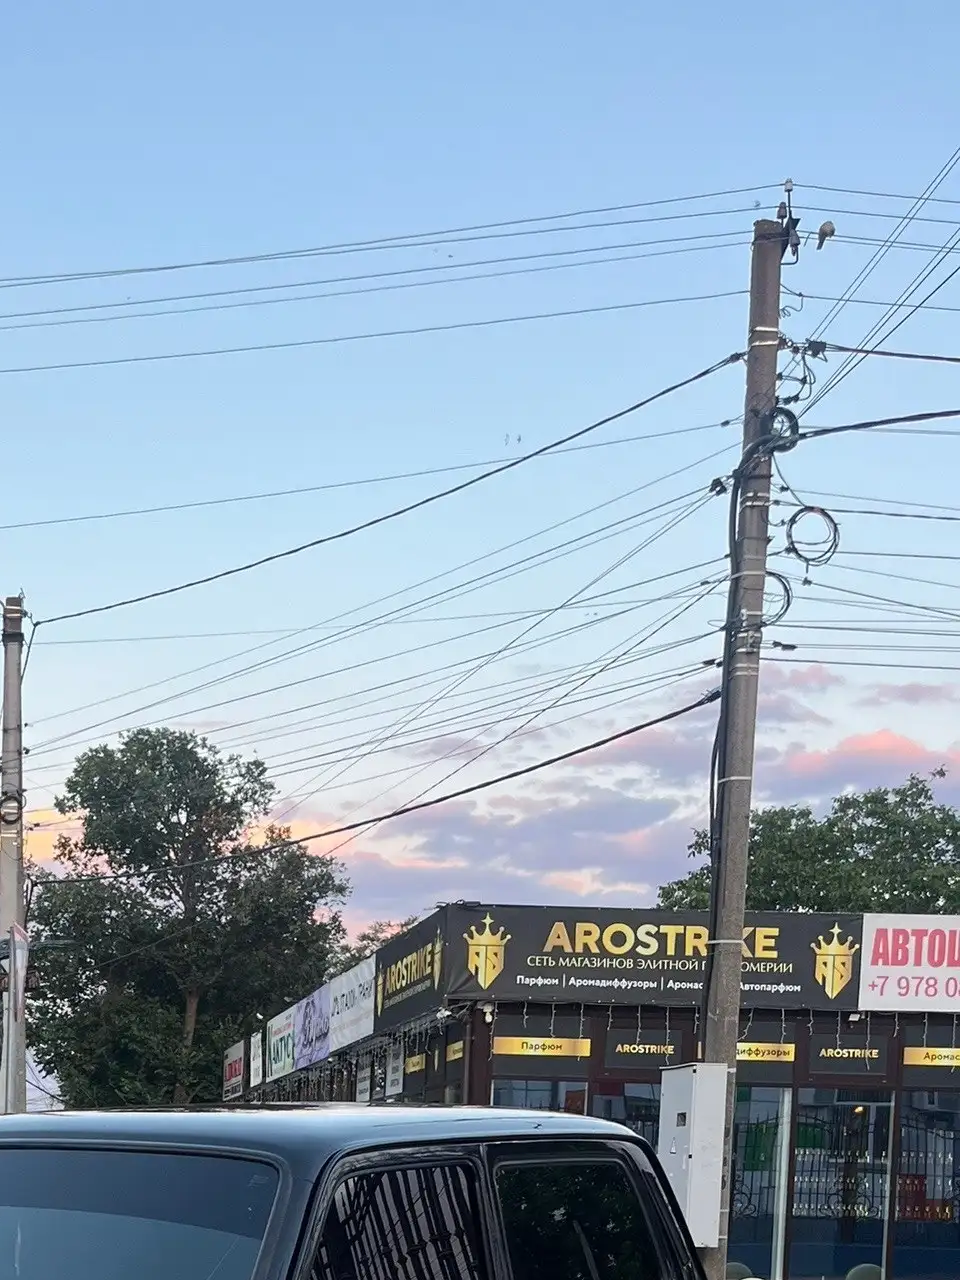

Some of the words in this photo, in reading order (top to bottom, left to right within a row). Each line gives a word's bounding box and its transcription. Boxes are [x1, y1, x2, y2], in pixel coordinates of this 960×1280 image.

[543, 921, 780, 959] AROSTRKE
[384, 943, 433, 996] AROSTRIKE
[527, 955, 555, 967] СЕТЬ
[558, 956, 634, 969] МАГАЗИНОВ
[637, 958, 699, 971] ЭЛИТНОЙ
[516, 975, 559, 986] Парфюм
[568, 976, 657, 989] Аромадиффузоры
[667, 979, 704, 990] Аромас
[868, 975, 889, 996] +7
[897, 976, 938, 997] 978
[945, 976, 960, 998] 0
[521, 1041, 563, 1052] Парфюм
[615, 1043, 675, 1054] AROSTRIKE
[737, 1047, 790, 1058] иффузоры
[819, 1048, 879, 1058] AROSTRIKE
[924, 1051, 960, 1063] Аромас
